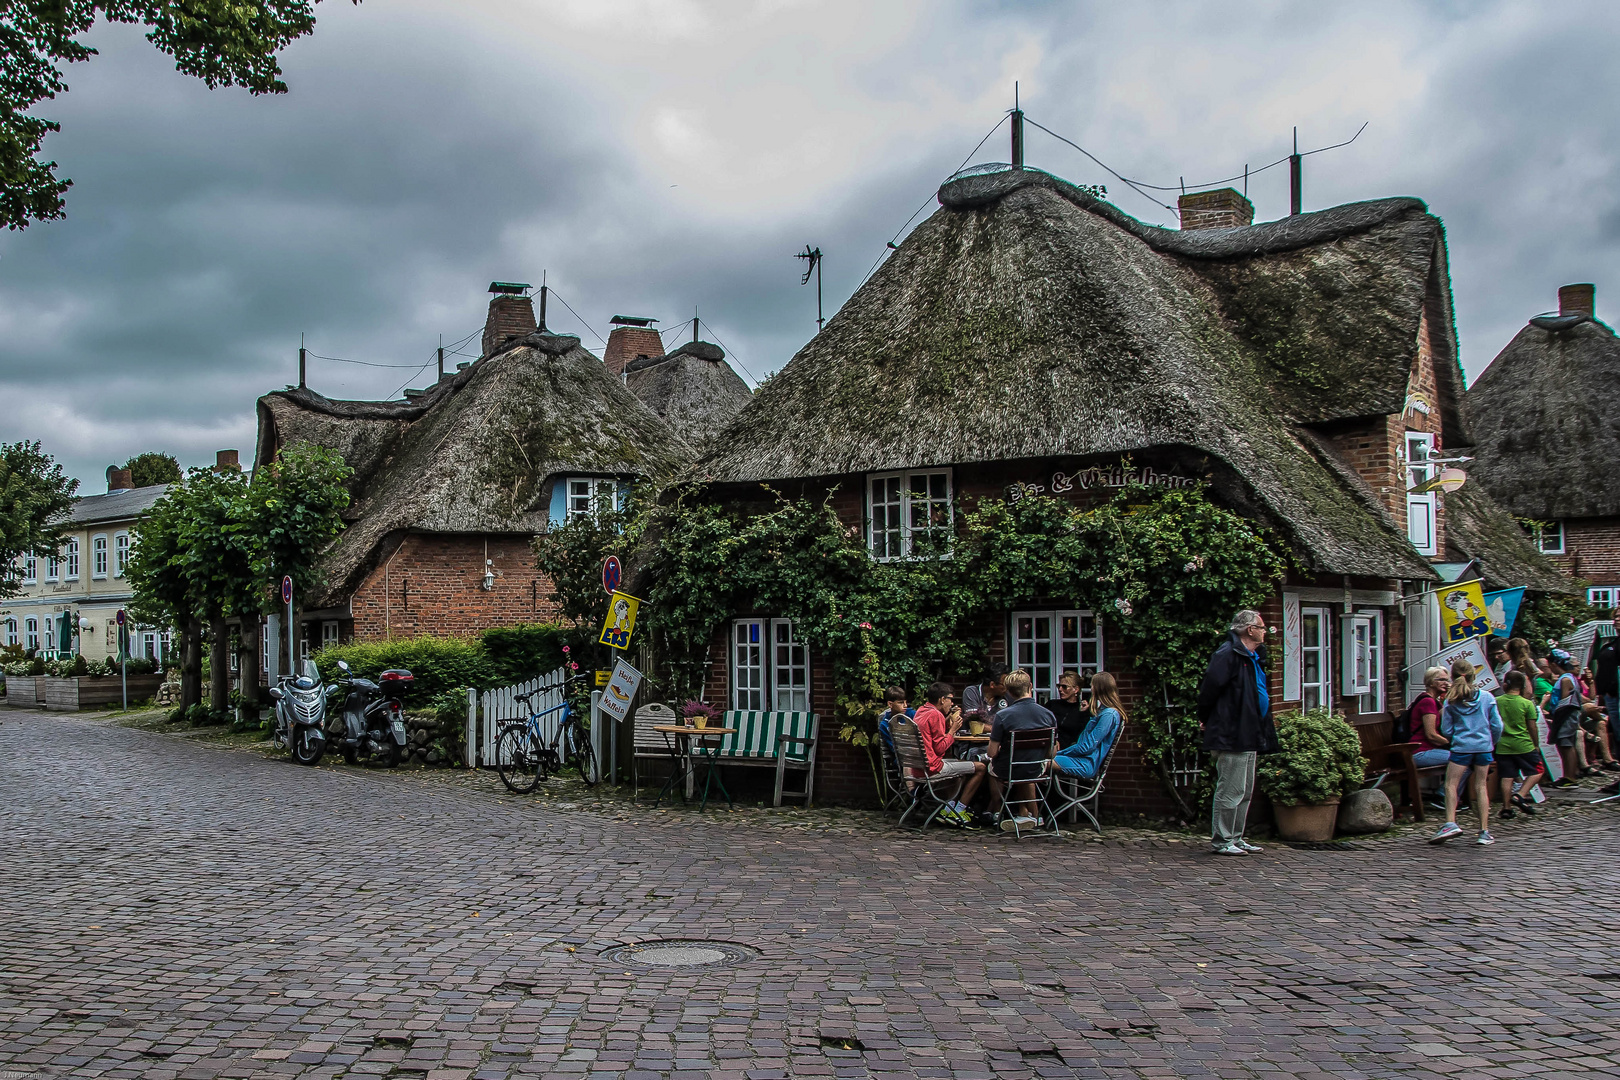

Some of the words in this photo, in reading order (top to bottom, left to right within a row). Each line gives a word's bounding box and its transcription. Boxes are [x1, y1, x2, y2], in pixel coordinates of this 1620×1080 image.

[1052, 472, 1073, 493] &
[1445, 650, 1474, 666] Heiße
[618, 669, 635, 686] Heiße
[603, 695, 625, 714] Waffeln
